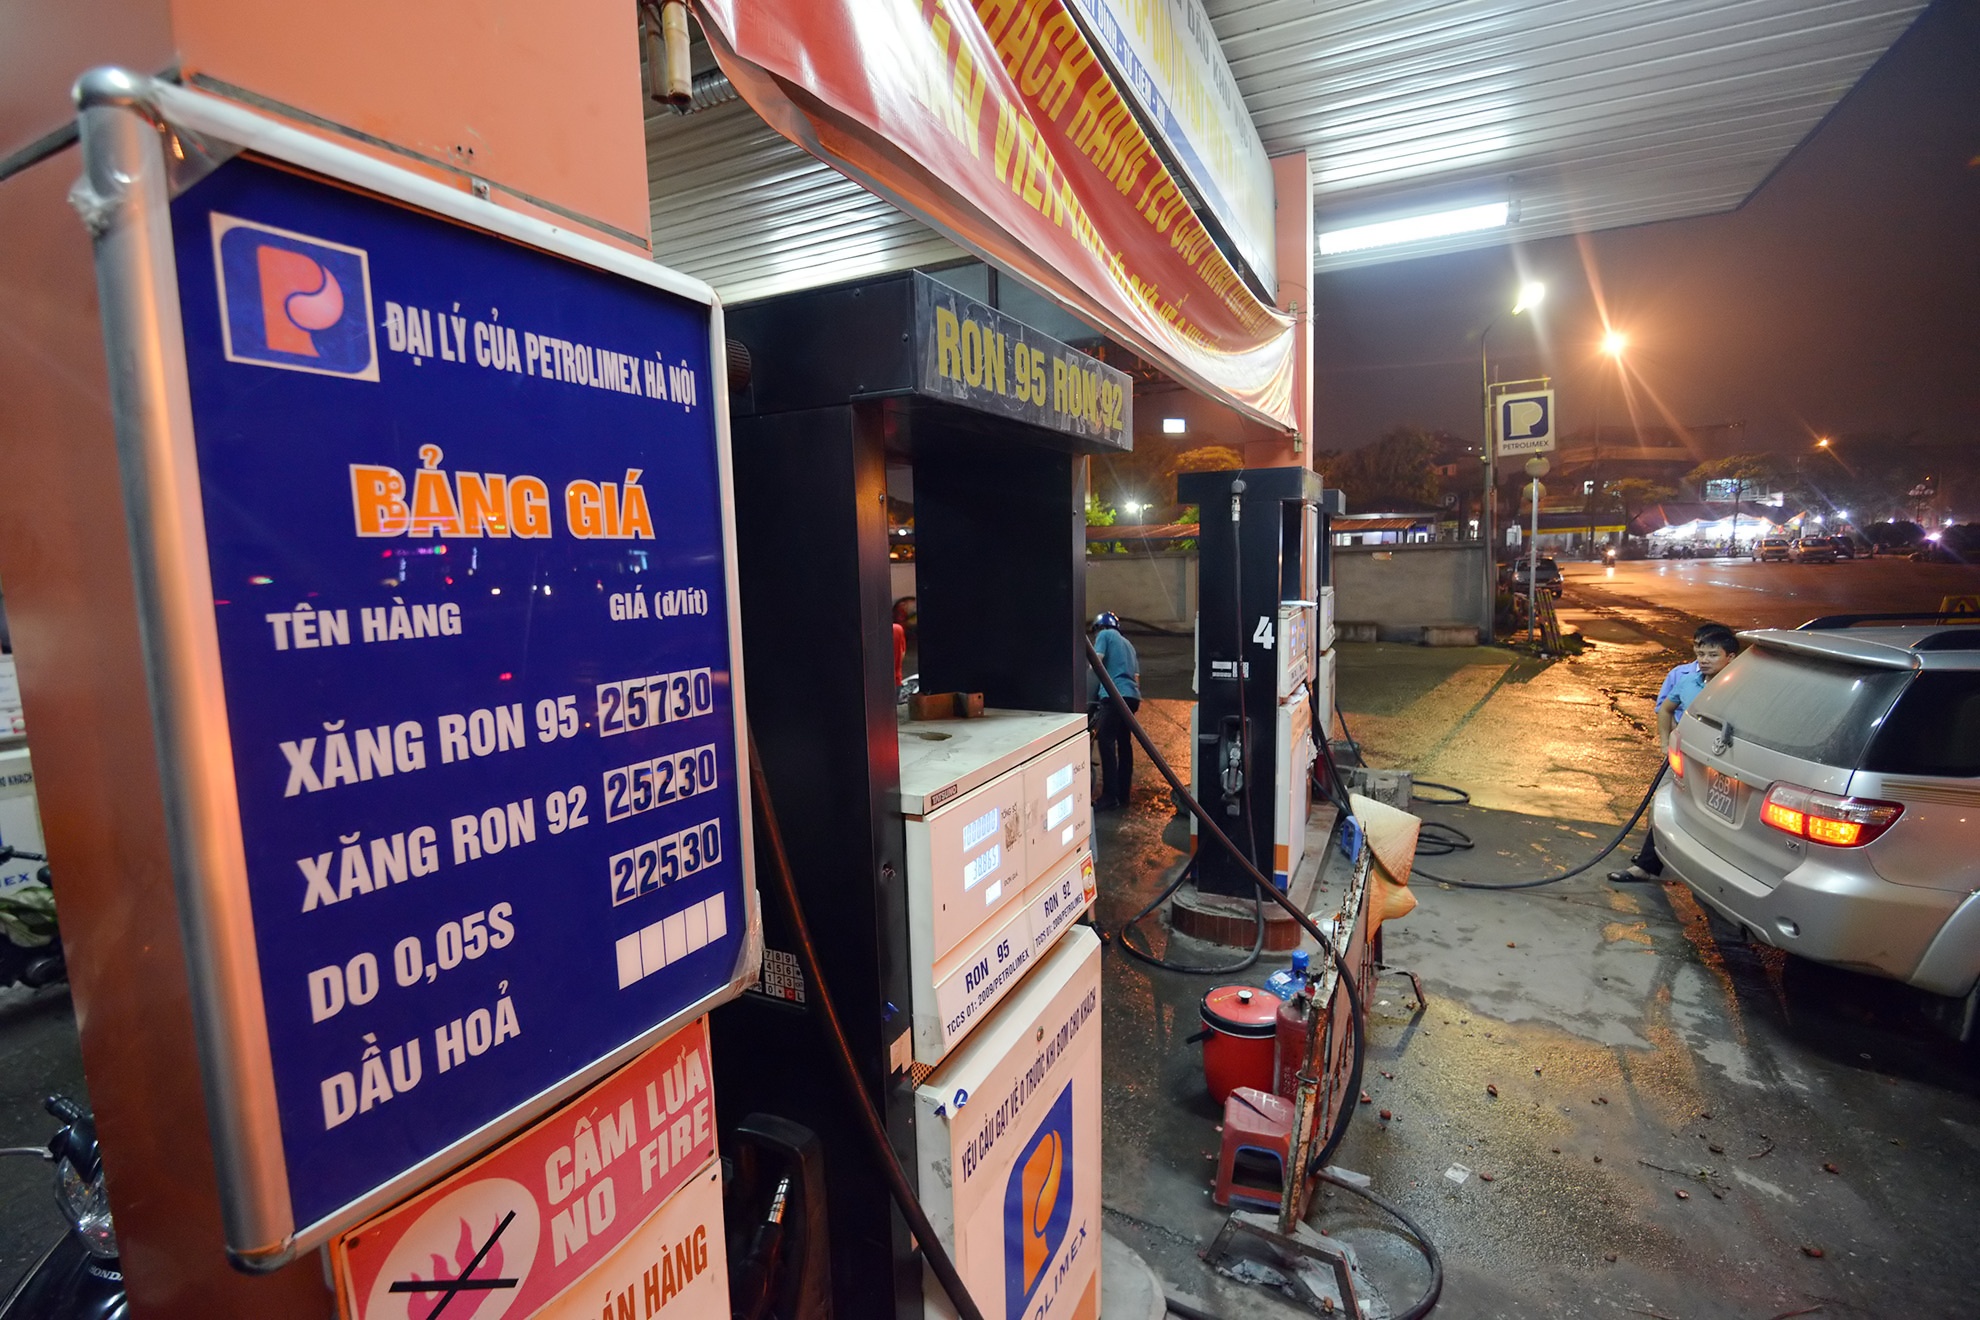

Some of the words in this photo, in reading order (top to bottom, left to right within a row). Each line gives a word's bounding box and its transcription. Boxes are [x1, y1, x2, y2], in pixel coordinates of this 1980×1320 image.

[385, 301, 434, 366] ĐẠI
[440, 302, 468, 362] LÝ
[474, 308, 523, 374] CỦA
[526, 331, 643, 395] PETROLIMEX
[645, 346, 669, 401] HÀ
[670, 362, 697, 413] NỘI
[936, 306, 1006, 395] RON
[1014, 342, 1046, 406] 95
[1053, 356, 1098, 423] RON
[1101, 379, 1123, 430] 92
[350, 444, 552, 538] BẢNG
[565, 468, 656, 539] GIÁ
[1503, 441, 1549, 450] PETROLIMEX
[266, 602, 350, 650] TÊN
[361, 597, 462, 642] HÀNG
[608, 584, 648, 621] GIÁ
[1252, 615, 1275, 650] 4
[280, 719, 425, 797] XĂNG
[437, 703, 525, 764] RON
[536, 695, 580, 744] 95
[600, 670, 712, 733] 25730
[297, 826, 440, 913] XĂNG
[450, 798, 536, 865] RON
[545, 785, 589, 837] 92
[607, 748, 718, 819] 25230
[1707, 789, 1731, 815] 2377
[307, 952, 380, 1024] DO
[393, 902, 515, 987] 0,05S
[614, 824, 721, 903] 22530
[1044, 891, 1059, 918] RON
[1062, 881, 1071, 899] 92
[947, 1011, 966, 1036] TCCS
[966, 999, 978, 1016] 01:
[978, 947, 1030, 1006] 2009/PETROLIMEX
[965, 957, 989, 994] RON
[996, 938, 1010, 963] 95
[320, 1032, 422, 1131] DẦU
[435, 979, 521, 1075] HOẢ
[962, 1137, 977, 1183] YÊU
[979, 1113, 994, 1161] CẦU
[995, 1105, 1009, 1137] GẠT
[1046, 1038, 1055, 1072] KHI
[1069, 1008, 1079, 1040] CHO
[1080, 986, 1096, 1026] KHÁCH
[544, 1098, 638, 1206] CẤM
[646, 1045, 707, 1131] LỬA
[551, 1176, 617, 1267] NO
[640, 1096, 710, 1194] FIRE
[643, 1224, 708, 1320] HÀNG
[1034, 1218, 1087, 1320] OLIMEX
